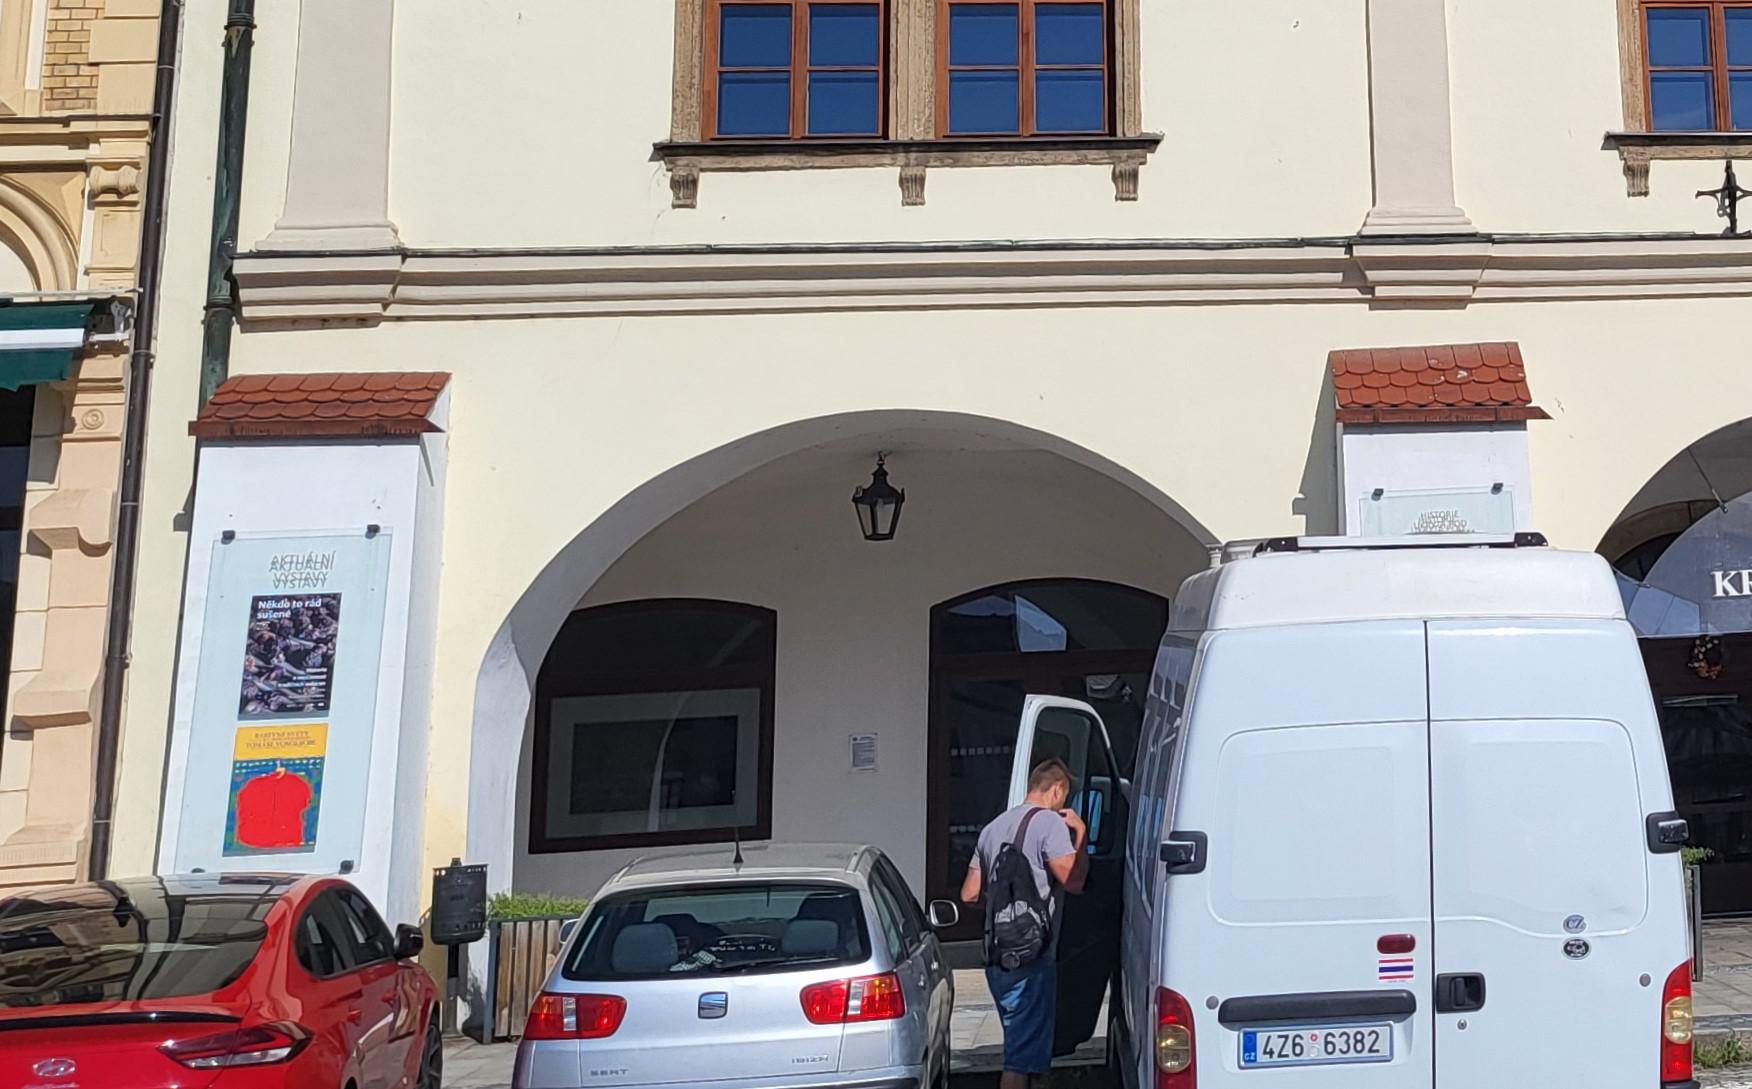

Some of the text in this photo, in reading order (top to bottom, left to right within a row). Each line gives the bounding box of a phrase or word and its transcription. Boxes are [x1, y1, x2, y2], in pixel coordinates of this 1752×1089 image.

[258, 598, 322, 609] Někdo to rád
[256, 609, 291, 620] sušené
[1262, 1029, 1380, 1059] 4Z6 6382
[1244, 1052, 1256, 1061] CZ
